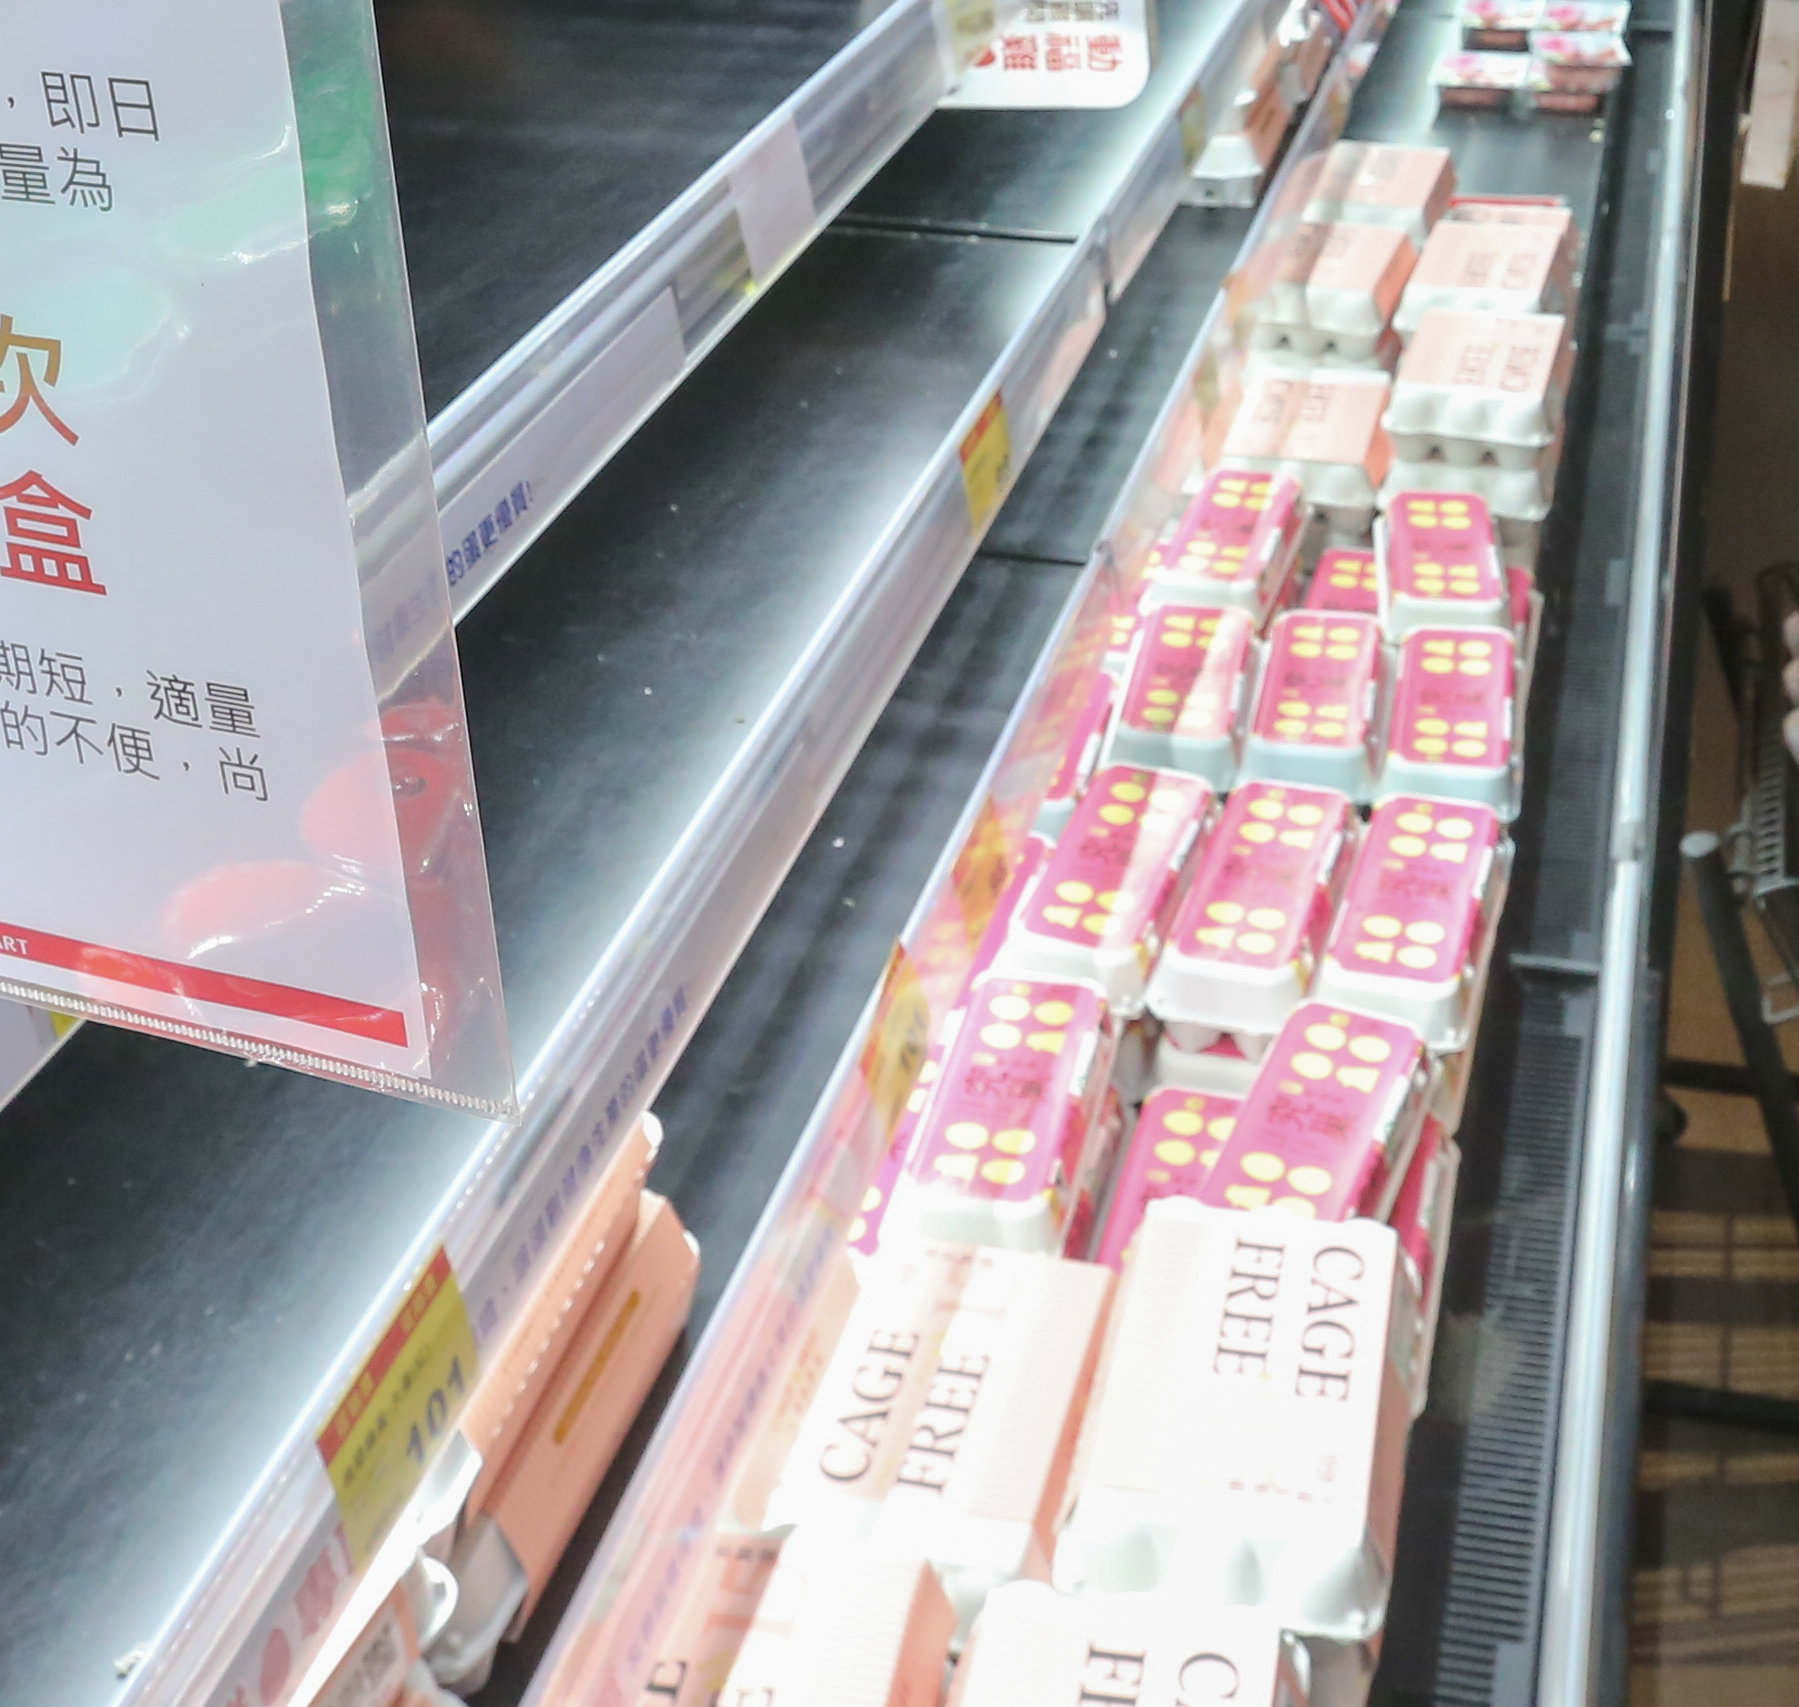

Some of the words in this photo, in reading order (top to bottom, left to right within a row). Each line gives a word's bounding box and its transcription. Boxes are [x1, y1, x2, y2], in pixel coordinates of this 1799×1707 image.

[1212, 1237, 1286, 1377] FREE
[1294, 1244, 1365, 1404] CAGE
[819, 1327, 920, 1484] CAGE
[898, 1352, 990, 1496] FREE
